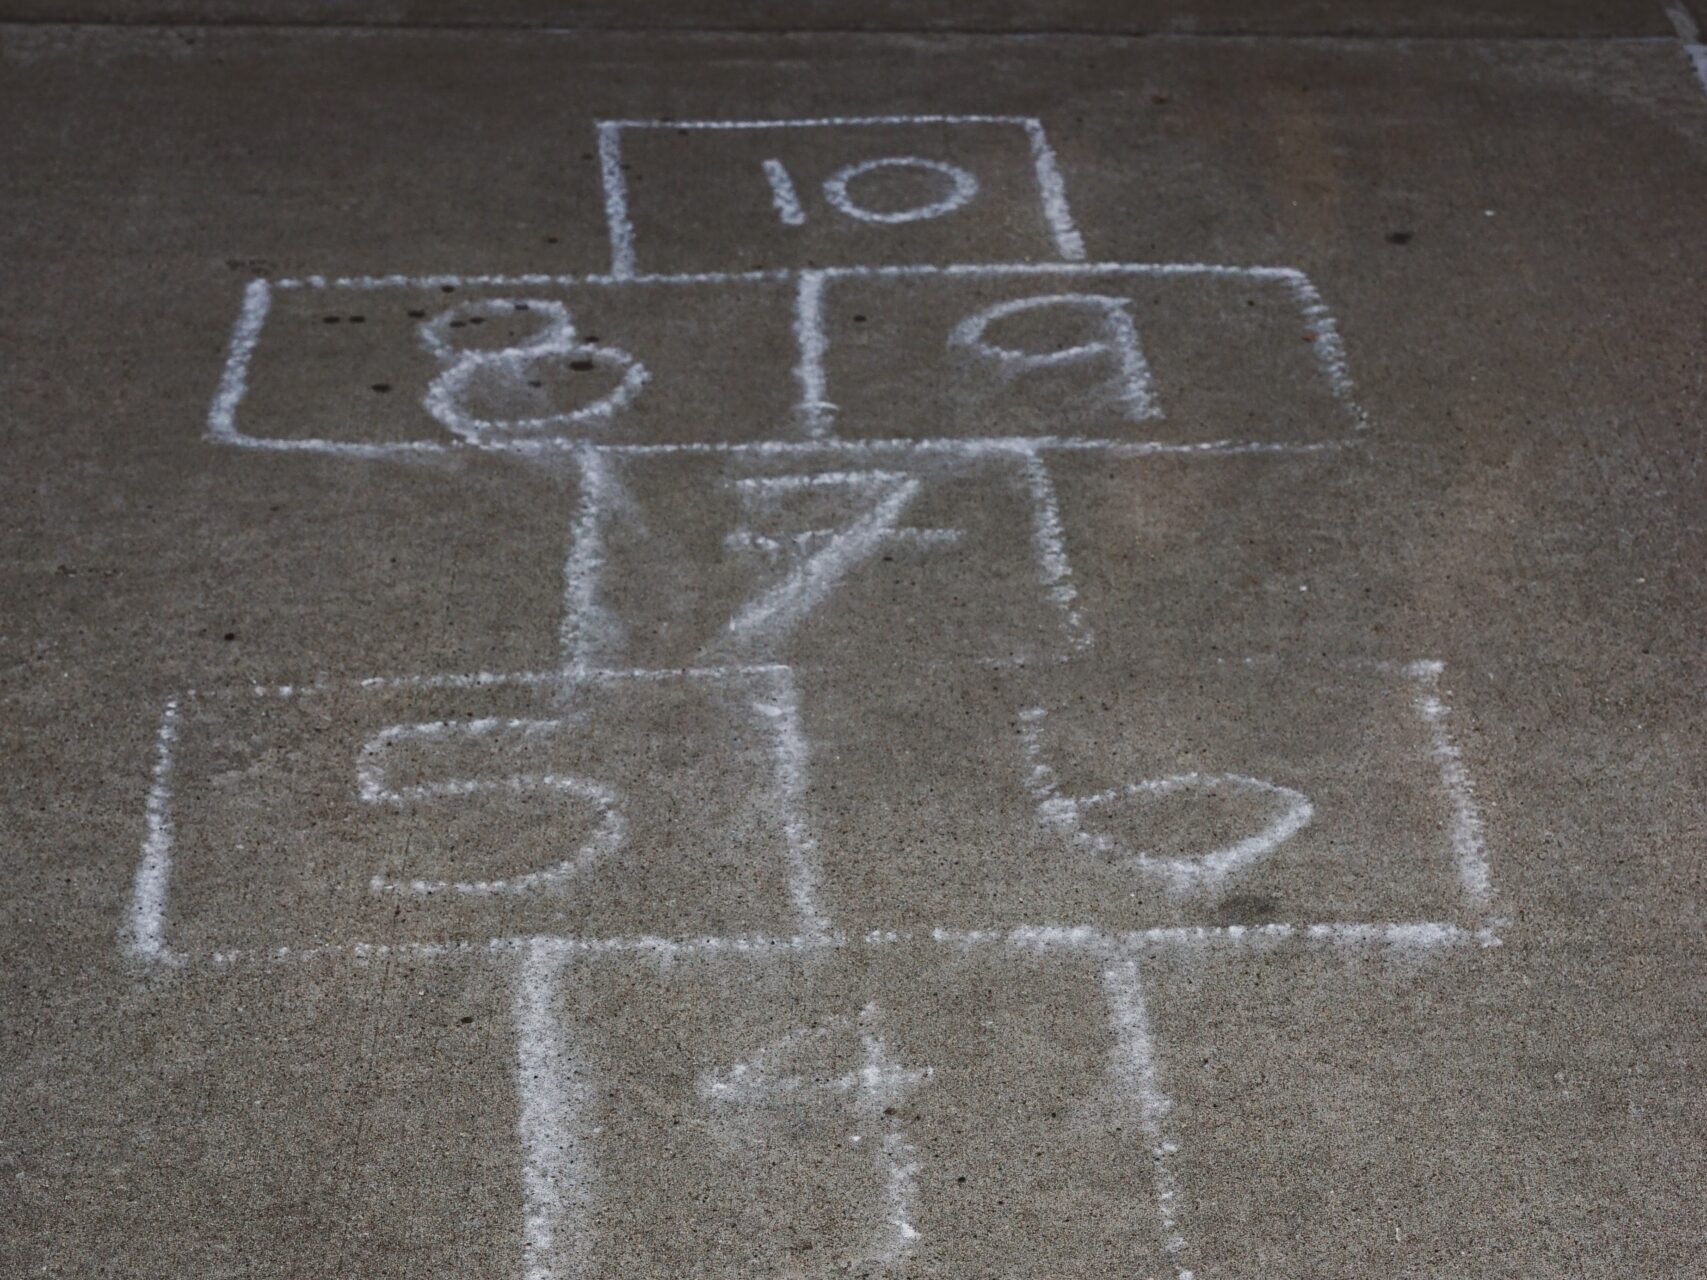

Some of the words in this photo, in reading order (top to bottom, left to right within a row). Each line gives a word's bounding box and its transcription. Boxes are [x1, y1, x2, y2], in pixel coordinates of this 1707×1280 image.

[763, 157, 980, 225] 10
[418, 297, 650, 447] 8
[952, 293, 1163, 423] 9
[722, 470, 964, 640] 7
[354, 714, 625, 896] 5
[1018, 704, 1316, 884] 6
[695, 1002, 935, 1268] 4
